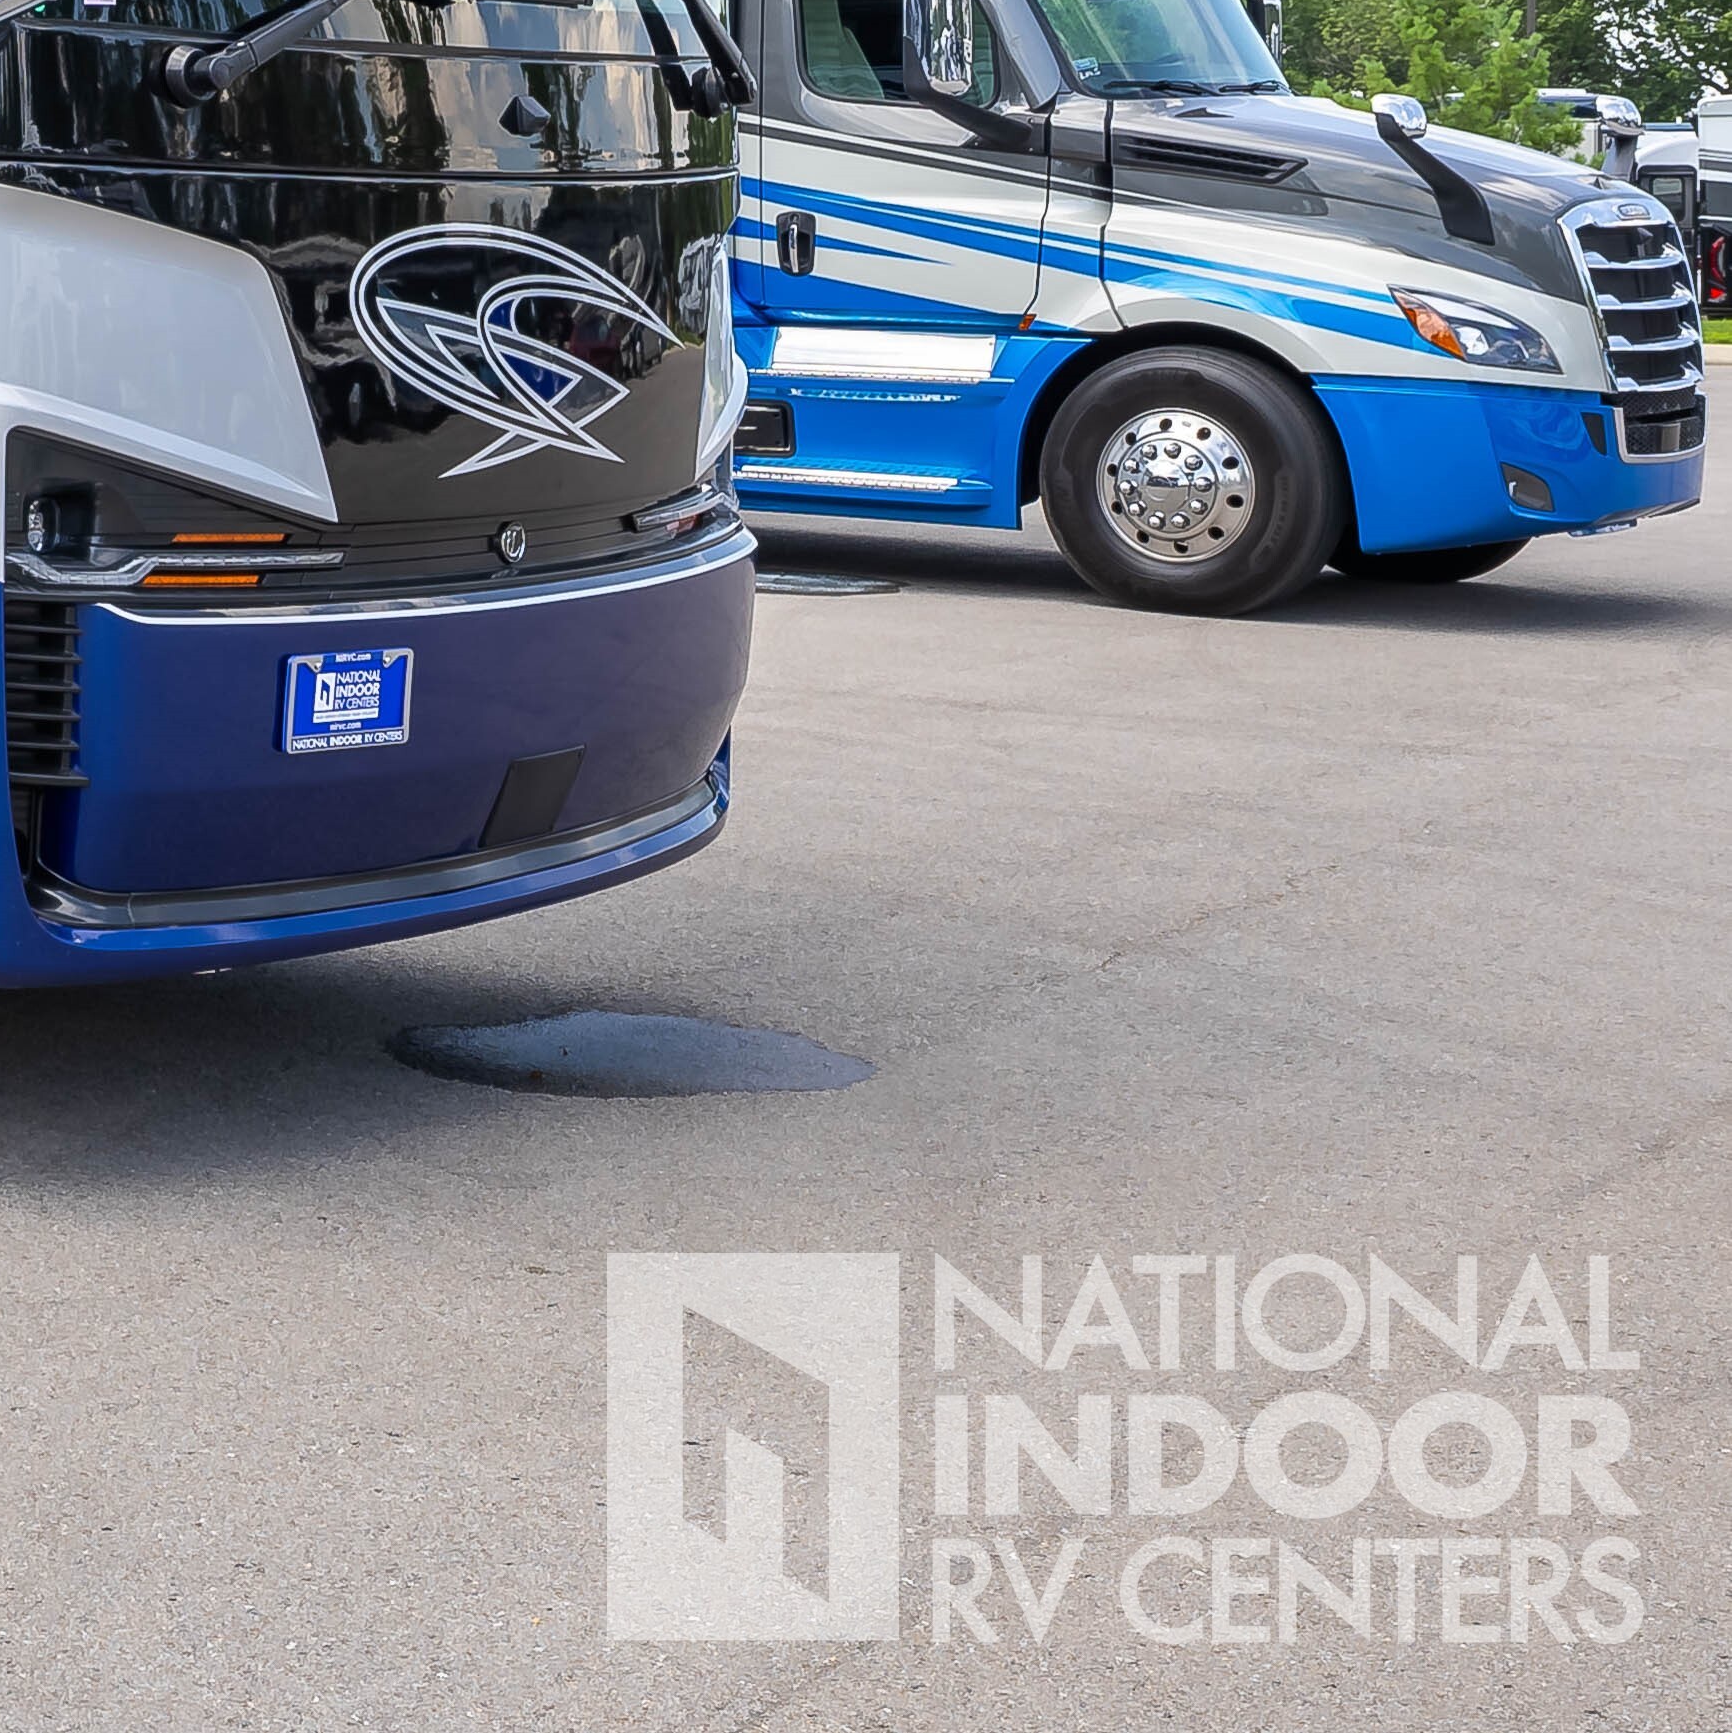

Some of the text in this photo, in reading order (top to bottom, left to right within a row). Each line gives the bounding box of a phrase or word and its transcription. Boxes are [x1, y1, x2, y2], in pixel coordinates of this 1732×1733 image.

[337, 669, 381, 684] NATIONAL
[335, 682, 380, 698] INDOOR
[335, 696, 380, 710] RV CENTERS
[293, 731, 403, 750] NATIONAL INDOOR RV CENTERS
